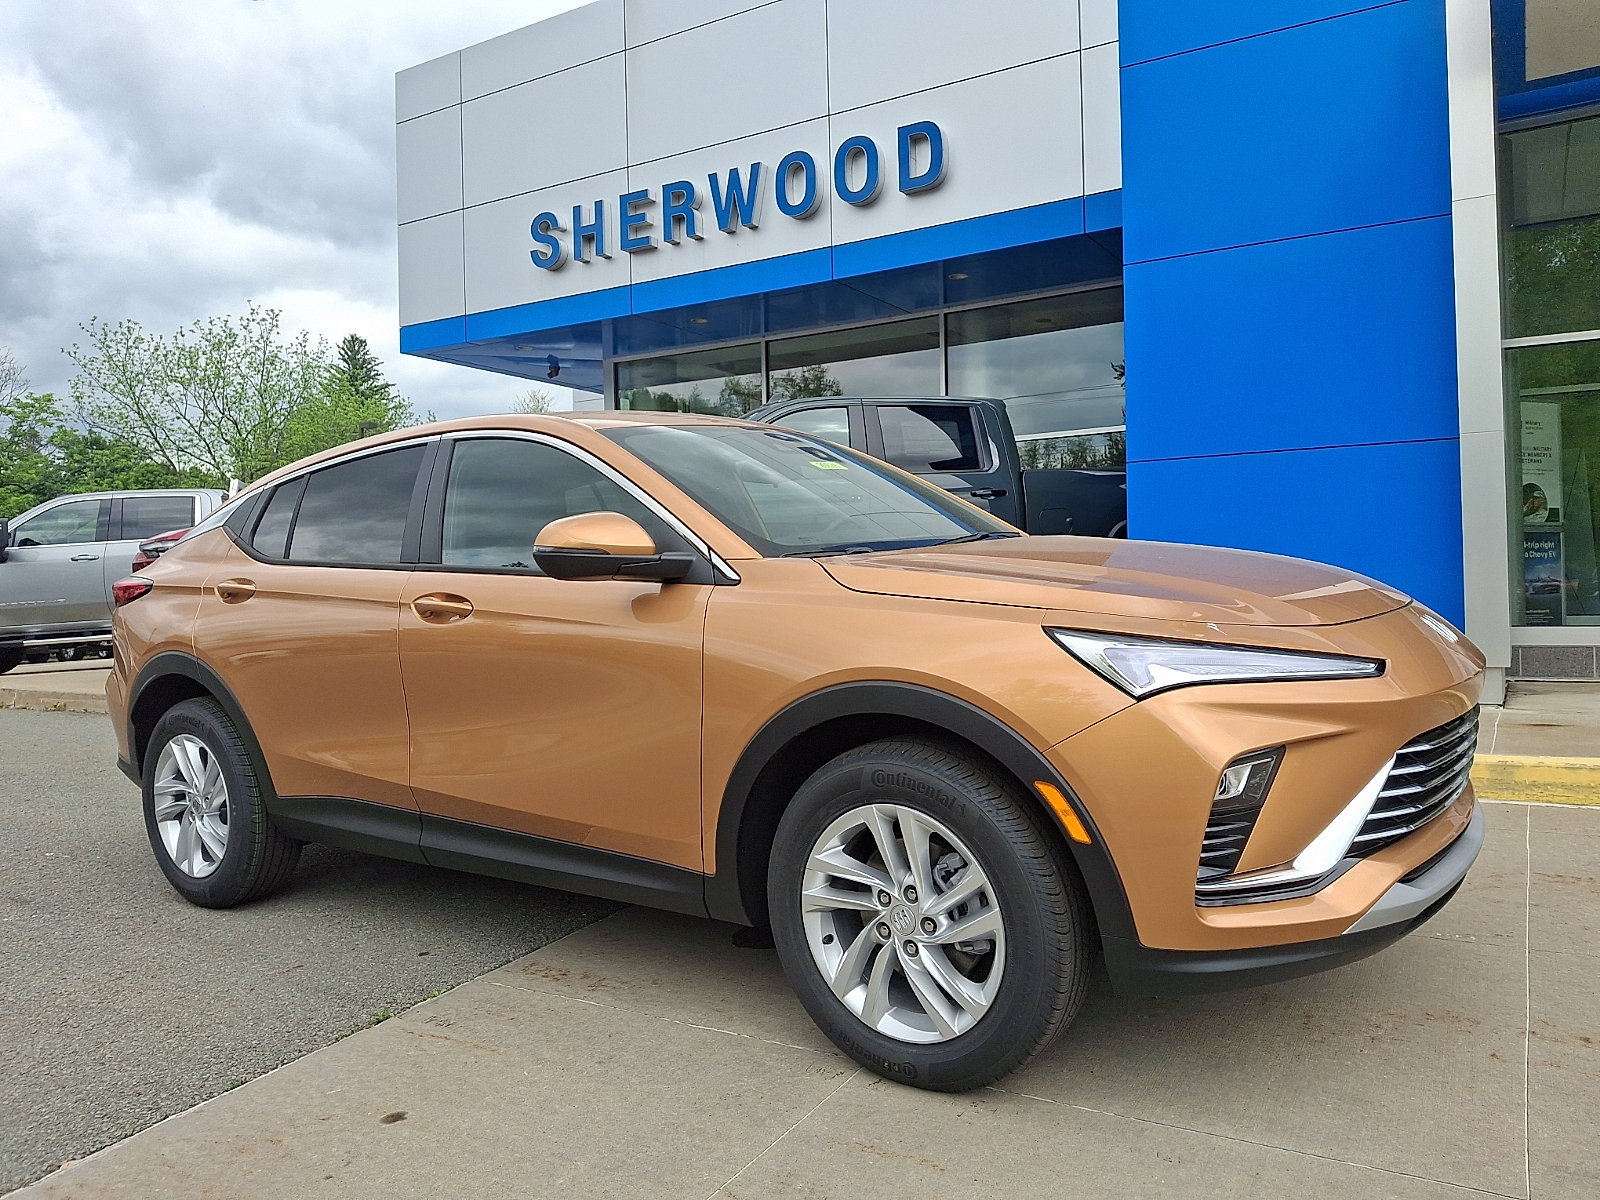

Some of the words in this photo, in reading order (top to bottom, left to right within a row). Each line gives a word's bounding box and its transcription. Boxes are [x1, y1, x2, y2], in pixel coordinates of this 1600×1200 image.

[530, 120, 947, 271] SHERWOOD
[1529, 550, 1548, 559] Chevy
[1540, 541, 1555, 549] right
[871, 769, 958, 811] Continental
